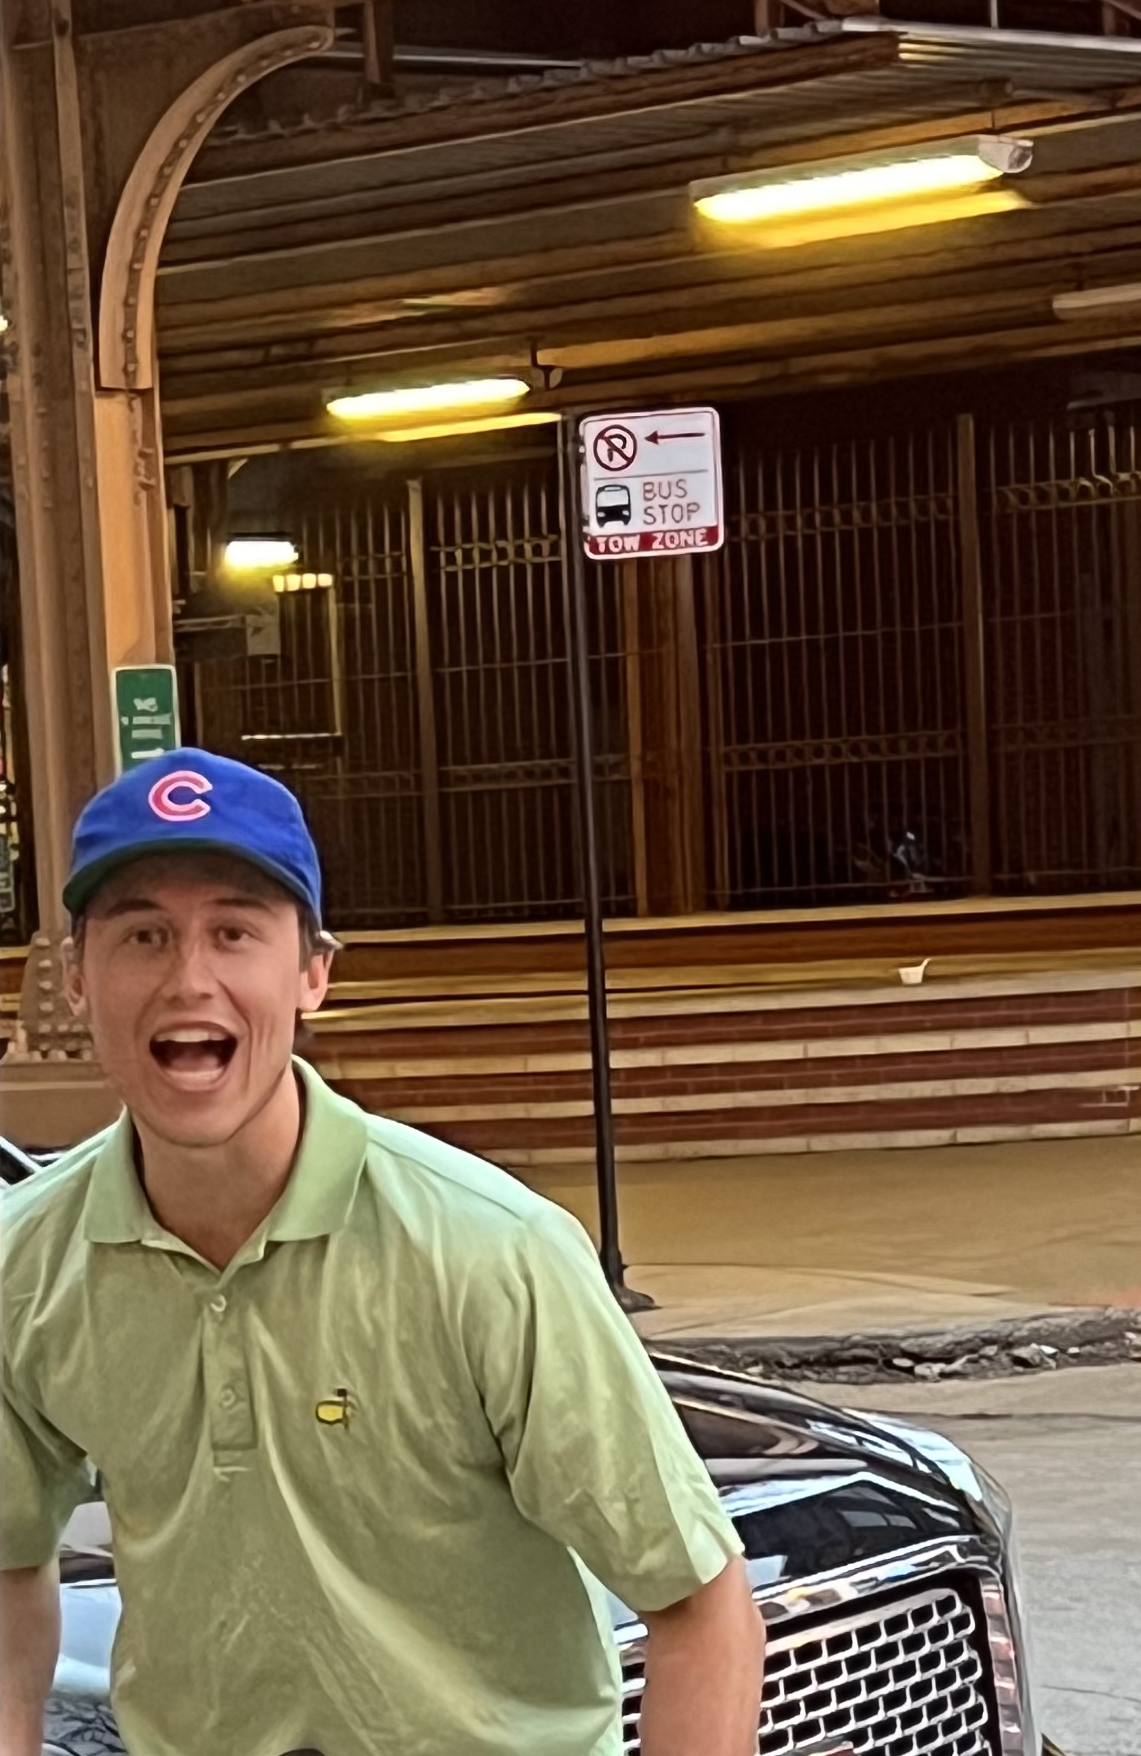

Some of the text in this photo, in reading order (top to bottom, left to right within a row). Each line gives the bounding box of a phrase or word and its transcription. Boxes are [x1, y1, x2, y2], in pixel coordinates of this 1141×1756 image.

[642, 479, 687, 501] BUS
[642, 502, 700, 525] STOP
[596, 528, 709, 554] TOW ZONE
[148, 770, 213, 821] C
